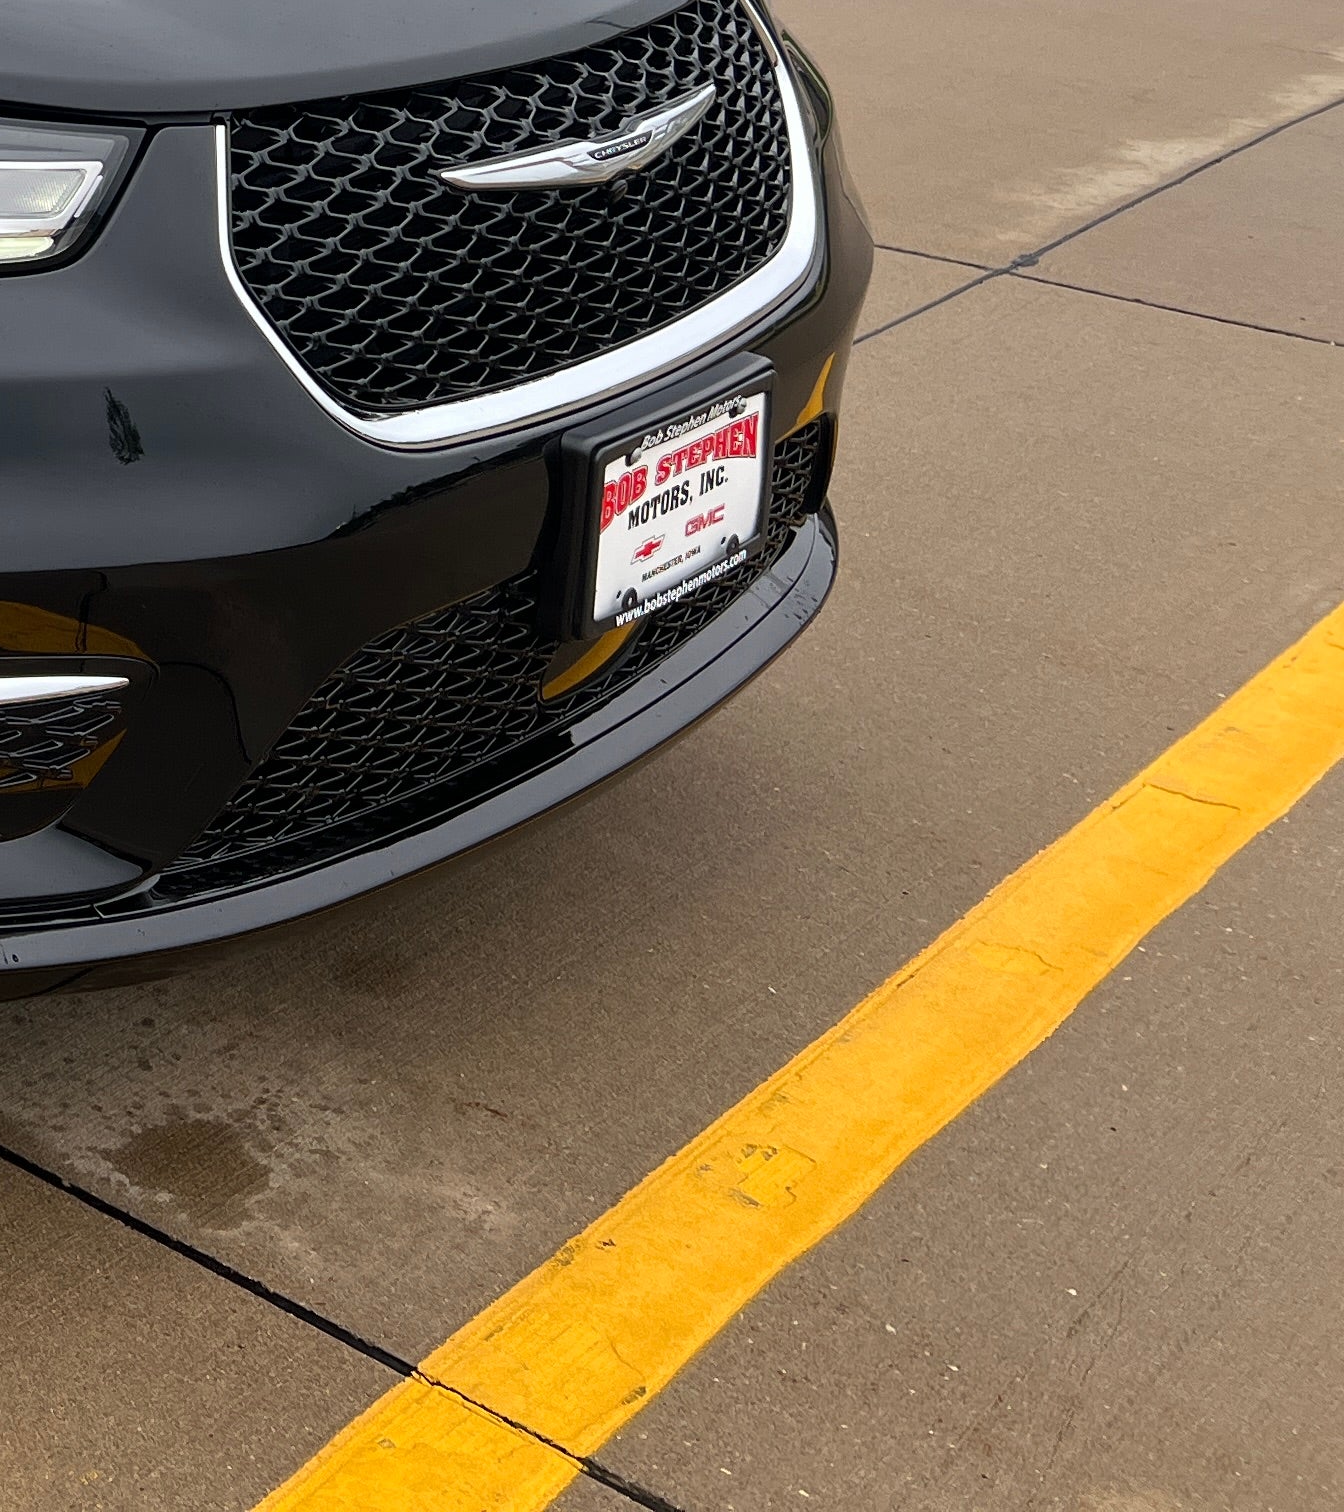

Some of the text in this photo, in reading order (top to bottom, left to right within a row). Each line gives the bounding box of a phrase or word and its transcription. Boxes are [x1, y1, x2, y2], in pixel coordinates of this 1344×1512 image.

[594, 137, 647, 159] CHRYSLER
[641, 394, 742, 451] Bob Stephen Motors
[600, 412, 760, 534] BOB STEPHEN
[627, 465, 729, 530] MOTORS, INC.
[684, 503, 726, 537] GMC
[615, 549, 747, 627] www.bobstephenmotors.com
